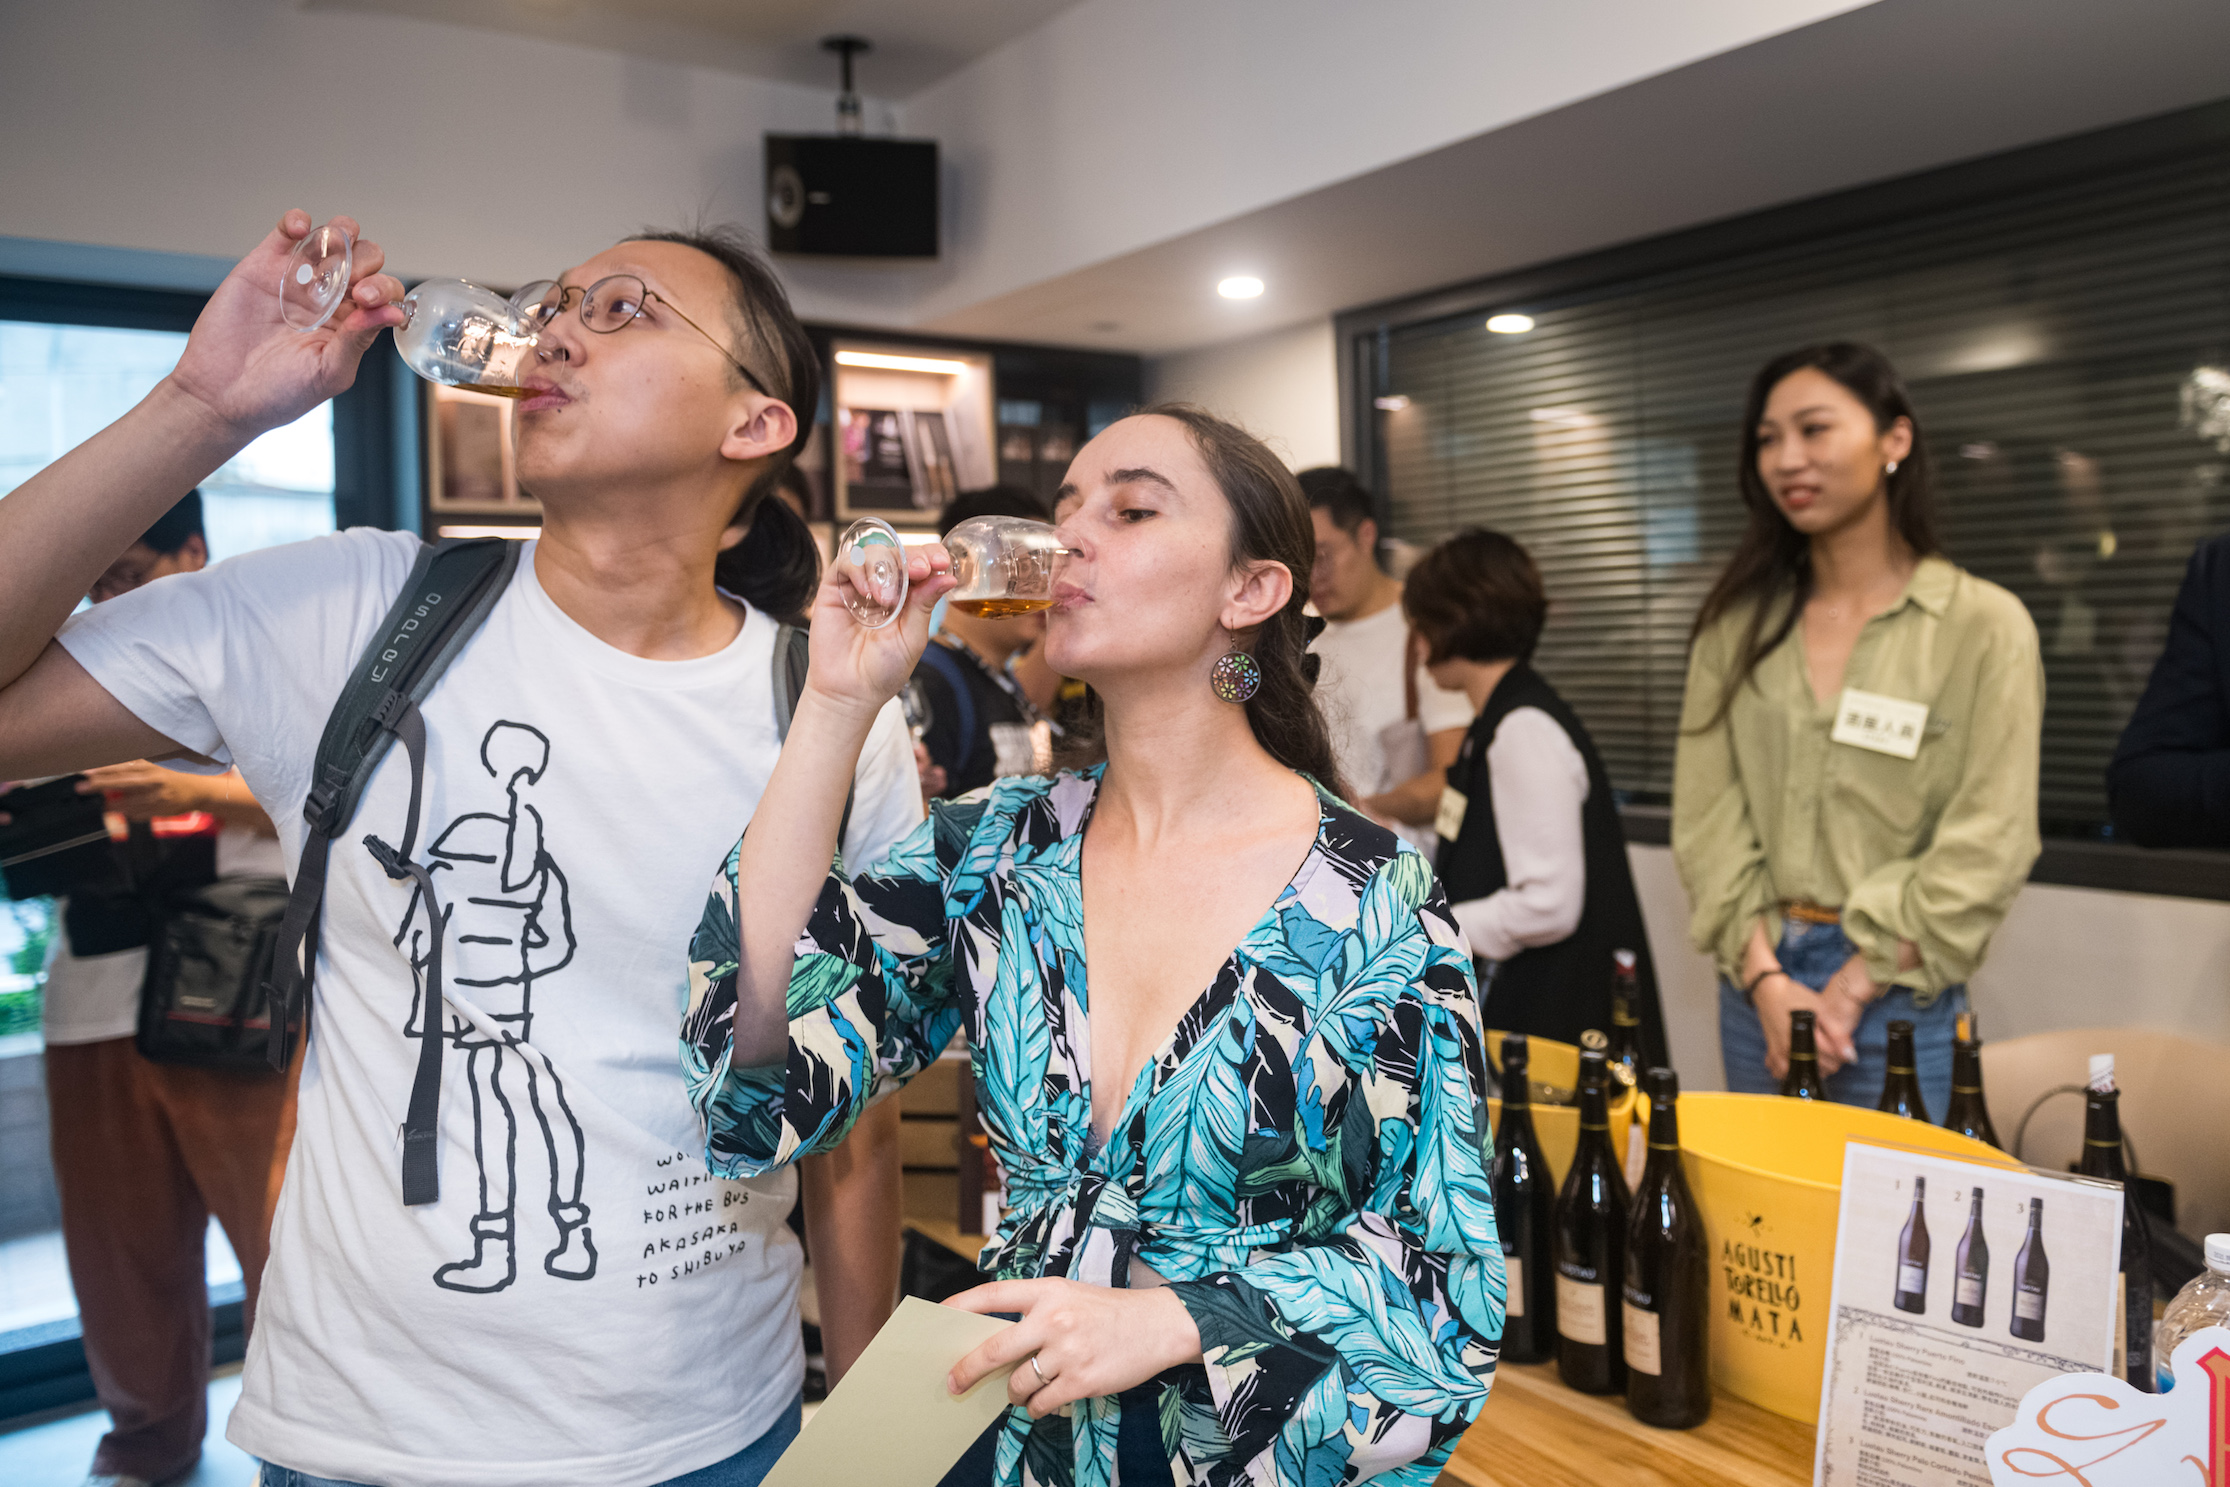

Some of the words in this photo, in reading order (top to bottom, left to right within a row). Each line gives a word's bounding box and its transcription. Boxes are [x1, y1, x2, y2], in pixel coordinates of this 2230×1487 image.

[657, 1151, 690, 1167] WO
[643, 1204, 678, 1224] FOR
[684, 1199, 713, 1216] THE
[723, 1191, 749, 1208] BUS
[1955, 1191, 1962, 1202] 2
[2018, 1203, 2024, 1214] 3
[643, 1222, 738, 1259] AKASAKA
[636, 1272, 658, 1289] TO
[671, 1240, 746, 1280] SHIBUYA
[1728, 1300, 1803, 1342] MATA
[1896, 1341, 1921, 1355] Sherry
[1922, 1347, 1947, 1360] Puerto
[1948, 1354, 1966, 1365] Fino
[1854, 1386, 1859, 1394] 2
[1890, 1396, 1915, 1409] Sherry
[1935, 1408, 1981, 1428] Amontillado
[1849, 1436, 1854, 1444] 3
[1886, 1447, 1911, 1461] Sherry
[1912, 1455, 1929, 1467] Palo
[1930, 1461, 1962, 1476] Cortado
